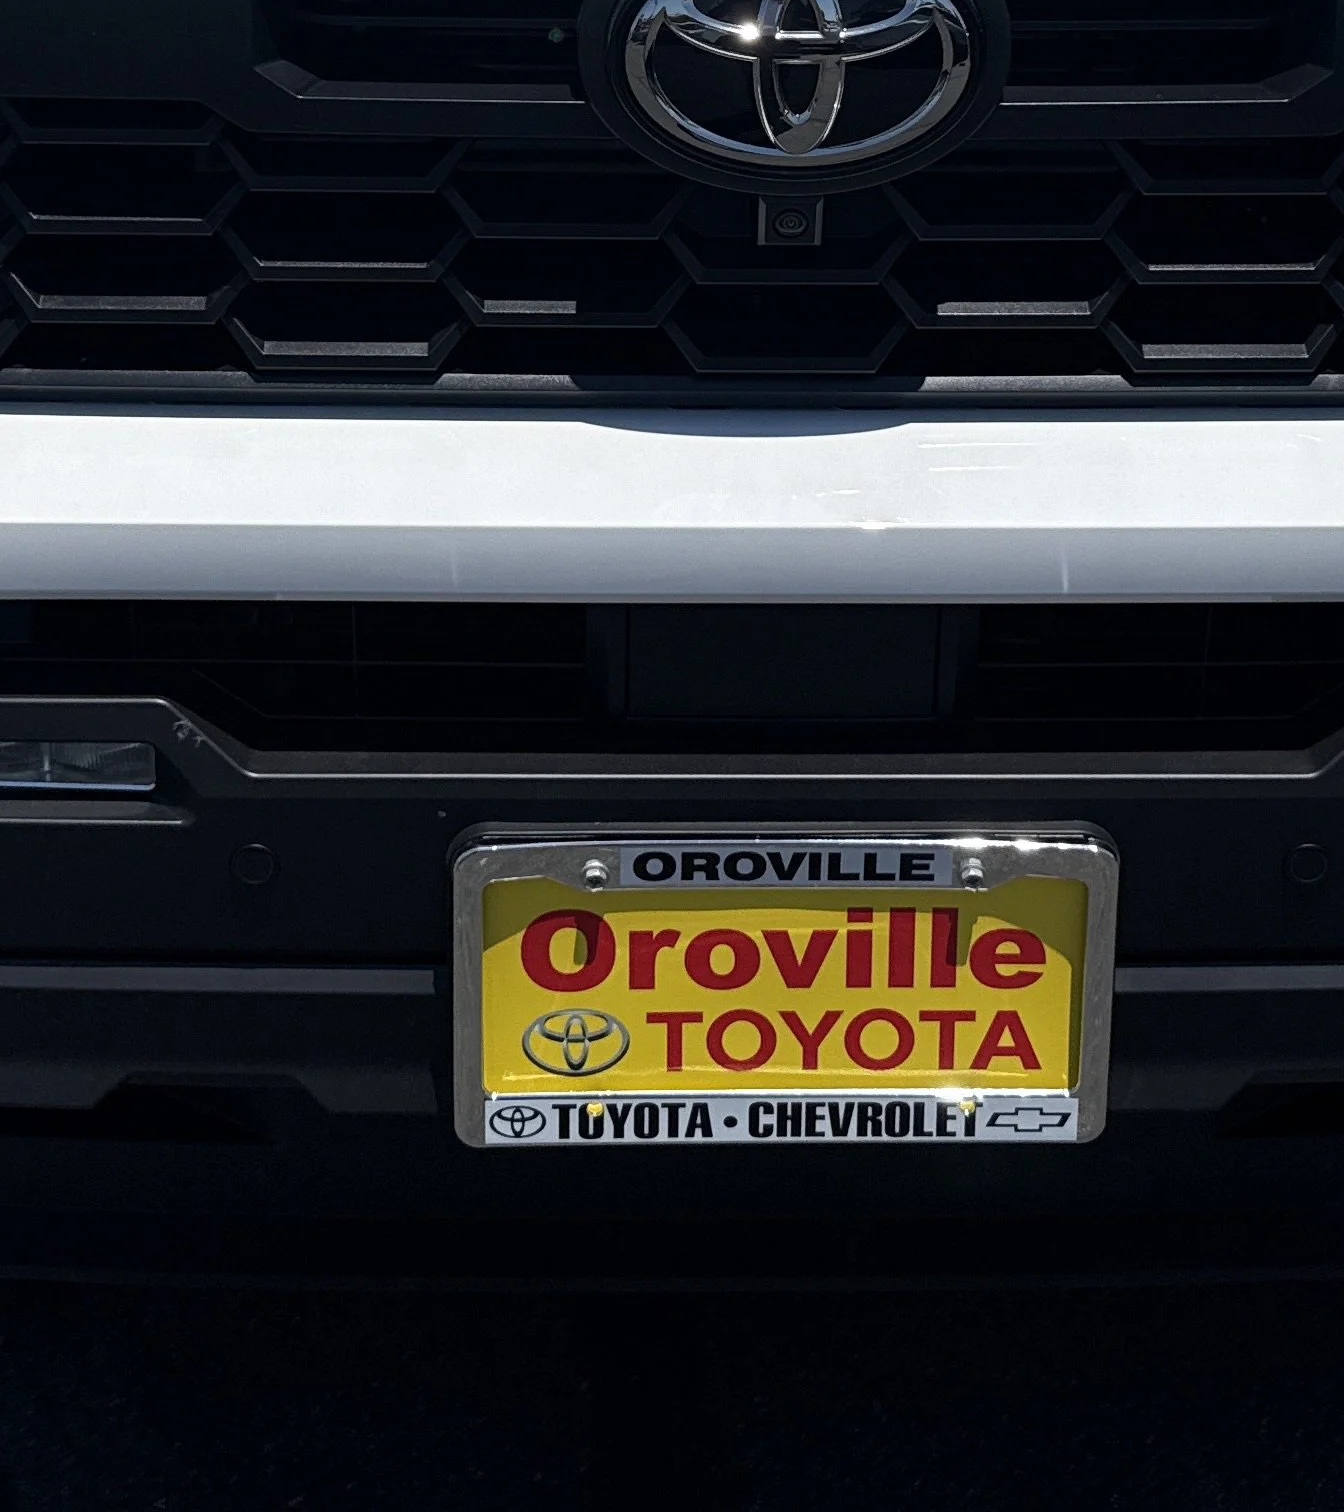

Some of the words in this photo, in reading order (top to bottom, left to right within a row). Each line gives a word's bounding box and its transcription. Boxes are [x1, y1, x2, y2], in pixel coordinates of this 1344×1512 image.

[632, 850, 935, 882] OROVILLE
[520, 906, 1047, 992] Oroville
[646, 1008, 1043, 1072] TOYOTA
[551, 1101, 714, 1140] TOYOTA
[747, 1100, 984, 1138] CHEVROLET
